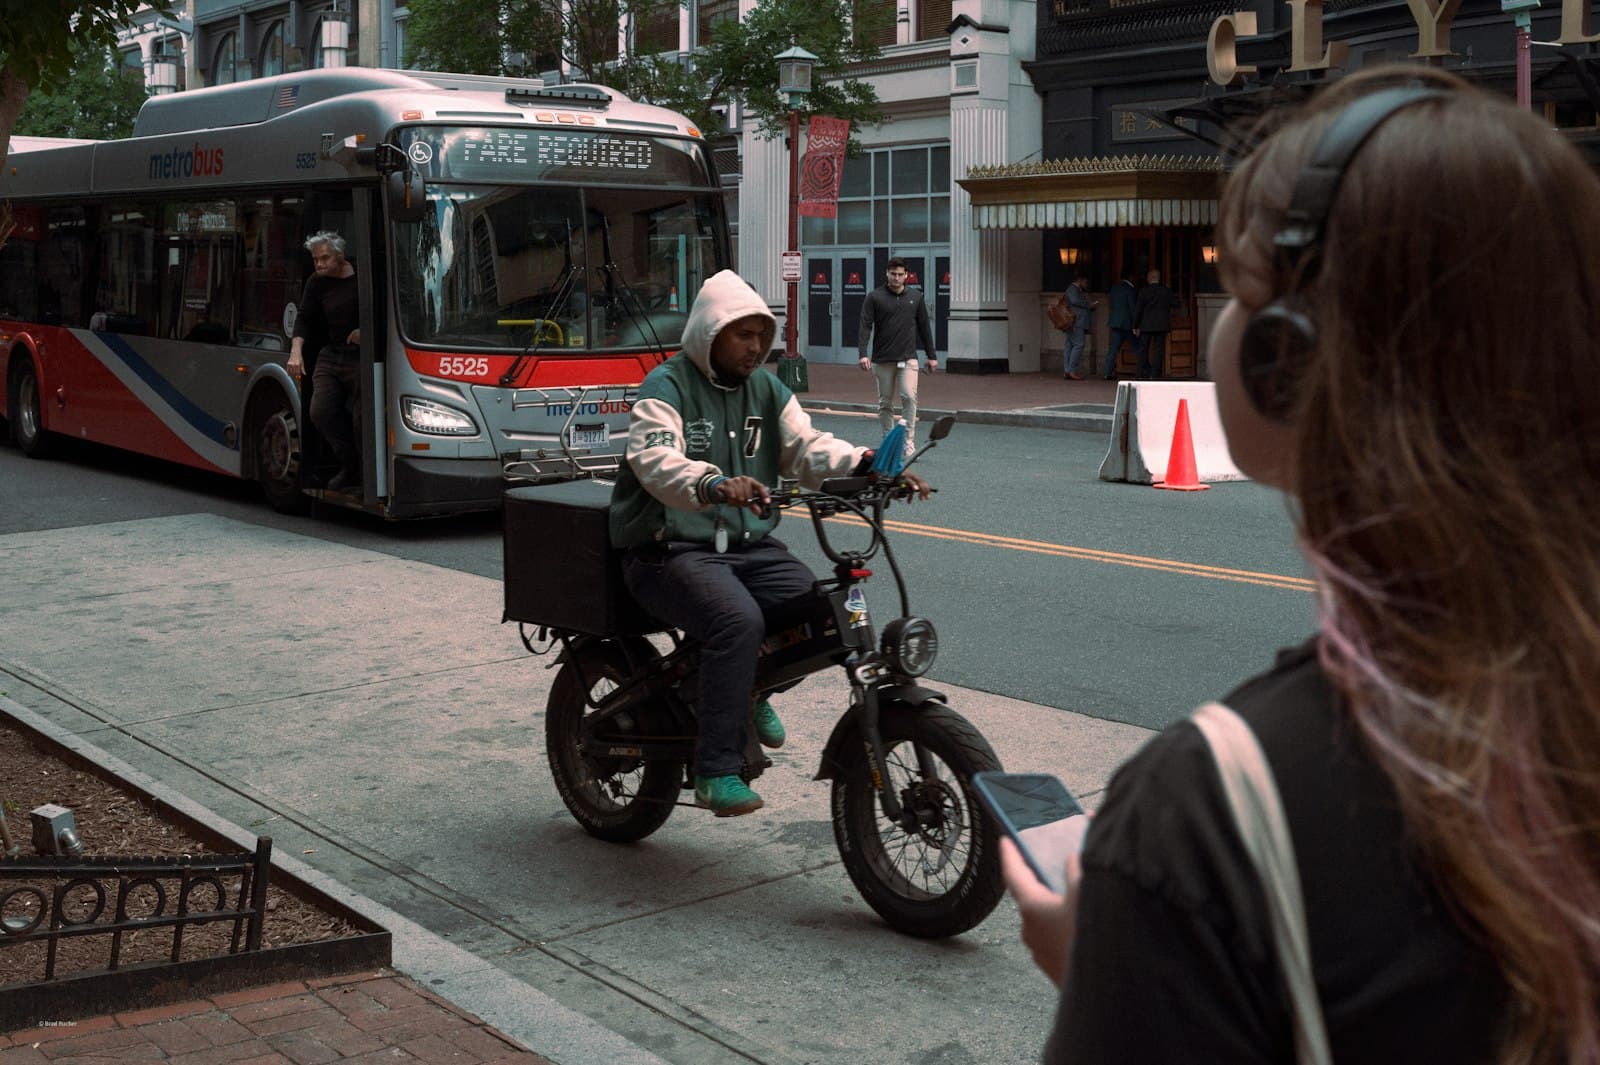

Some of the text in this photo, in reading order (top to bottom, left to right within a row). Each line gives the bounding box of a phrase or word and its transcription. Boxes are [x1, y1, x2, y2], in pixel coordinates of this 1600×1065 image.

[149, 143, 224, 180] metrobus
[296, 152, 317, 169] 5525
[464, 131, 652, 169] FARE REQUIRED
[439, 357, 489, 376] 5525
[645, 431, 675, 449] 28
[743, 416, 763, 458] 7
